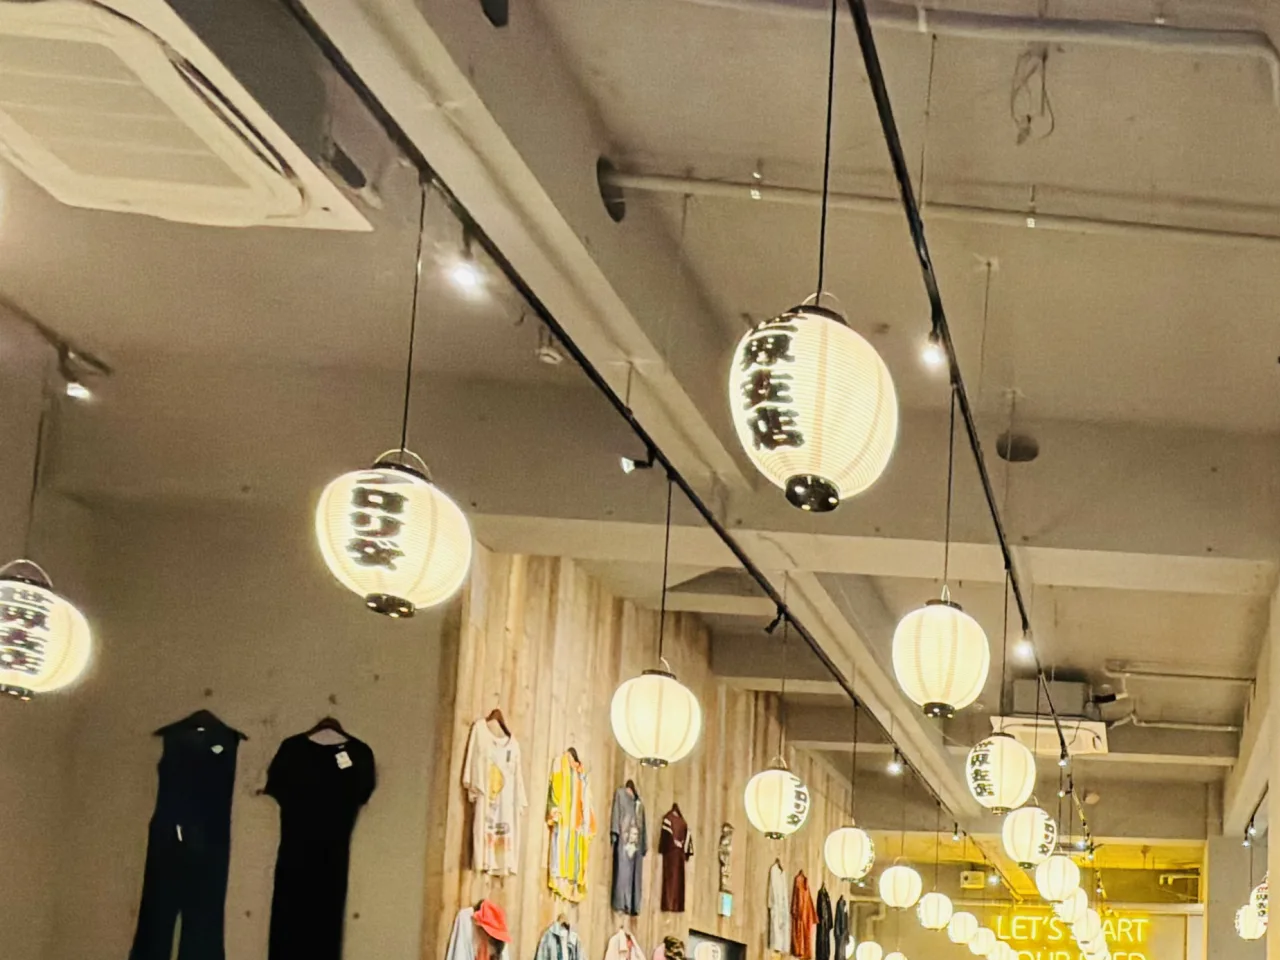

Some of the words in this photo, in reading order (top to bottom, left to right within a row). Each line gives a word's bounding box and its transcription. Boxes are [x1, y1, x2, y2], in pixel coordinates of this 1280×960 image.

[346, 471, 414, 571] フロリダ
[997, 915, 1063, 941] LET'S
[1069, 918, 1149, 943] ART
